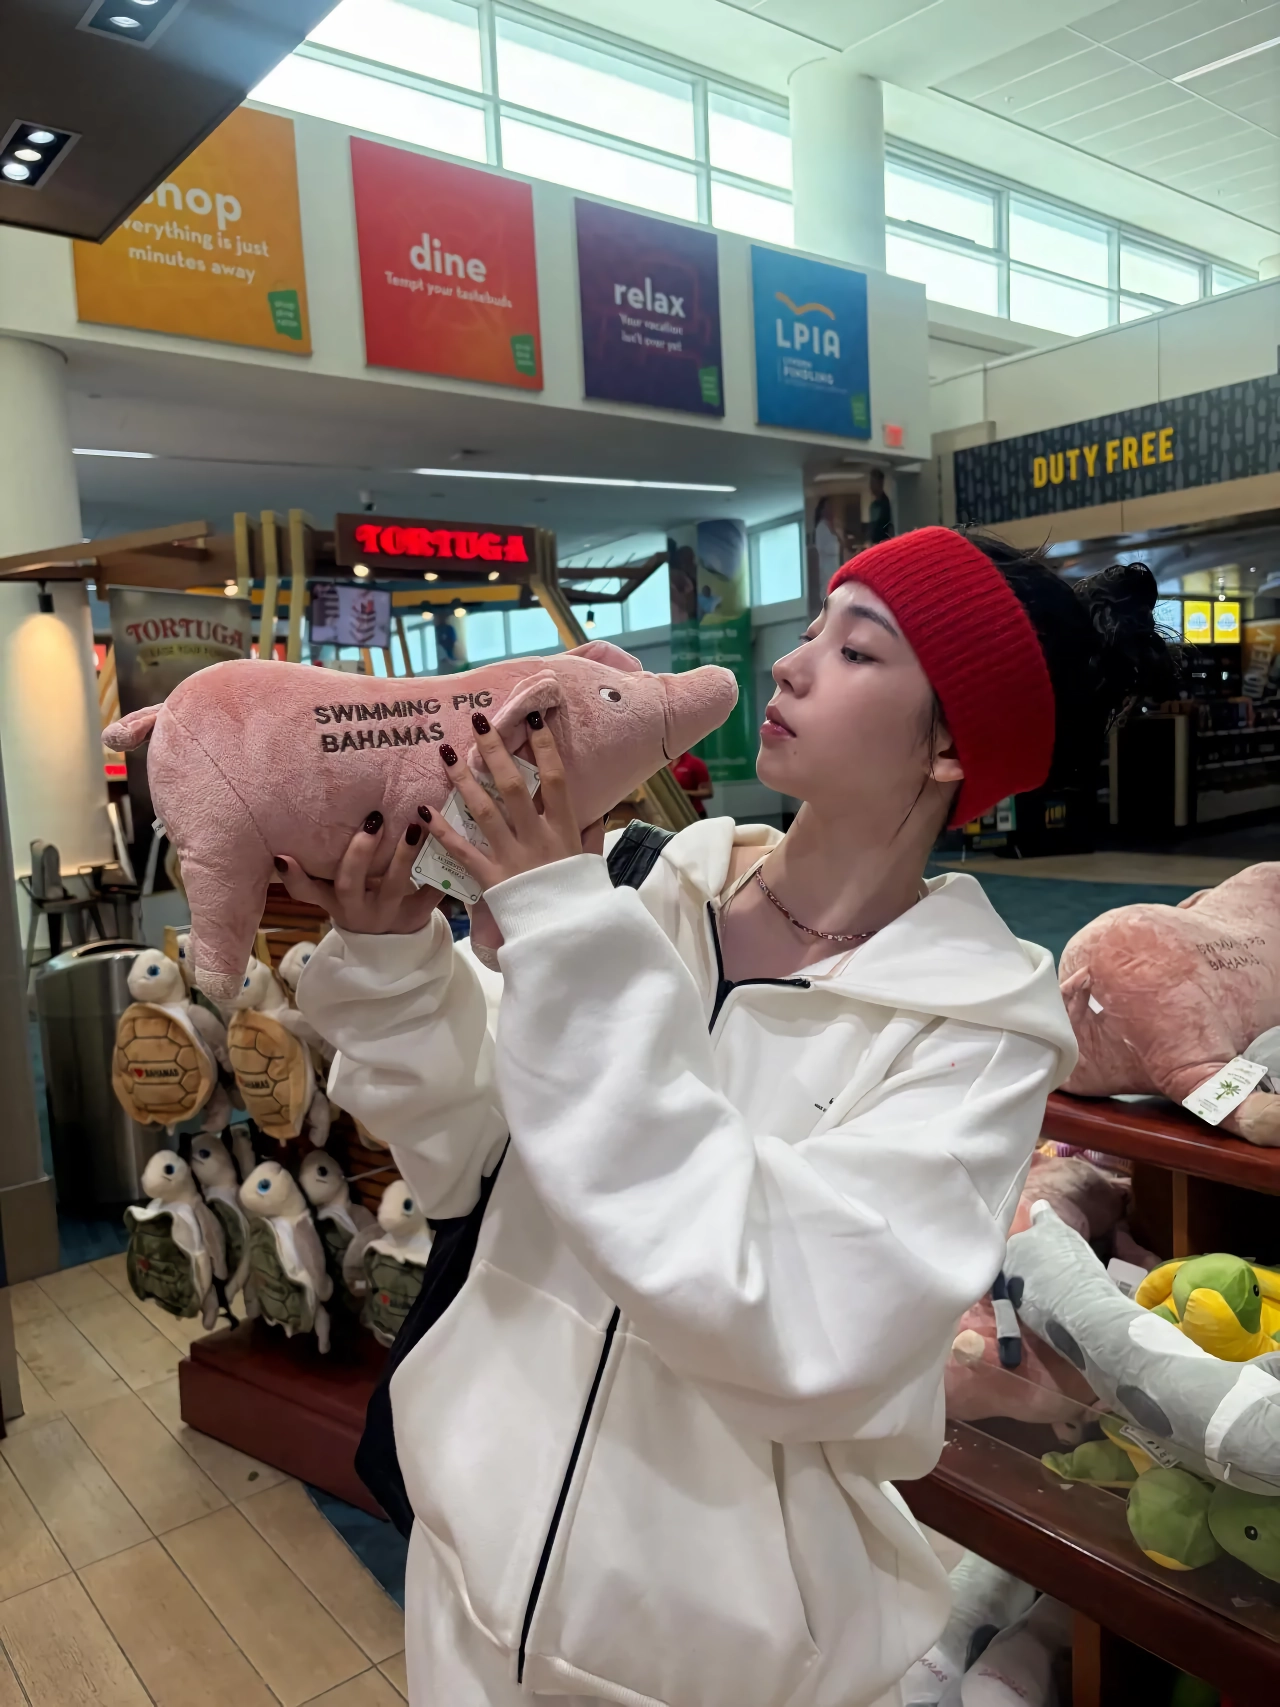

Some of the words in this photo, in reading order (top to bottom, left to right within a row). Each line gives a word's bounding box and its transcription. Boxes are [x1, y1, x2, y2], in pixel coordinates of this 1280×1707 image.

[120, 219, 213, 251] verything
[217, 232, 232, 249] is
[236, 236, 269, 257] just
[128, 246, 206, 271] minutes
[211, 261, 256, 284] away
[410, 232, 487, 283] dine
[384, 270, 424, 293] Tempt
[426, 282, 453, 296] your
[613, 277, 686, 319] relax
[775, 318, 841, 360] LPIA
[1032, 444, 1099, 488] DUTY
[1105, 427, 1174, 474] FREE
[355, 523, 529, 563] TORTUGA
[126, 617, 244, 651] TORTUGA
[314, 698, 442, 725] SWIMMING
[452, 690, 493, 712] PIG
[320, 722, 445, 753] BAHAMAS
